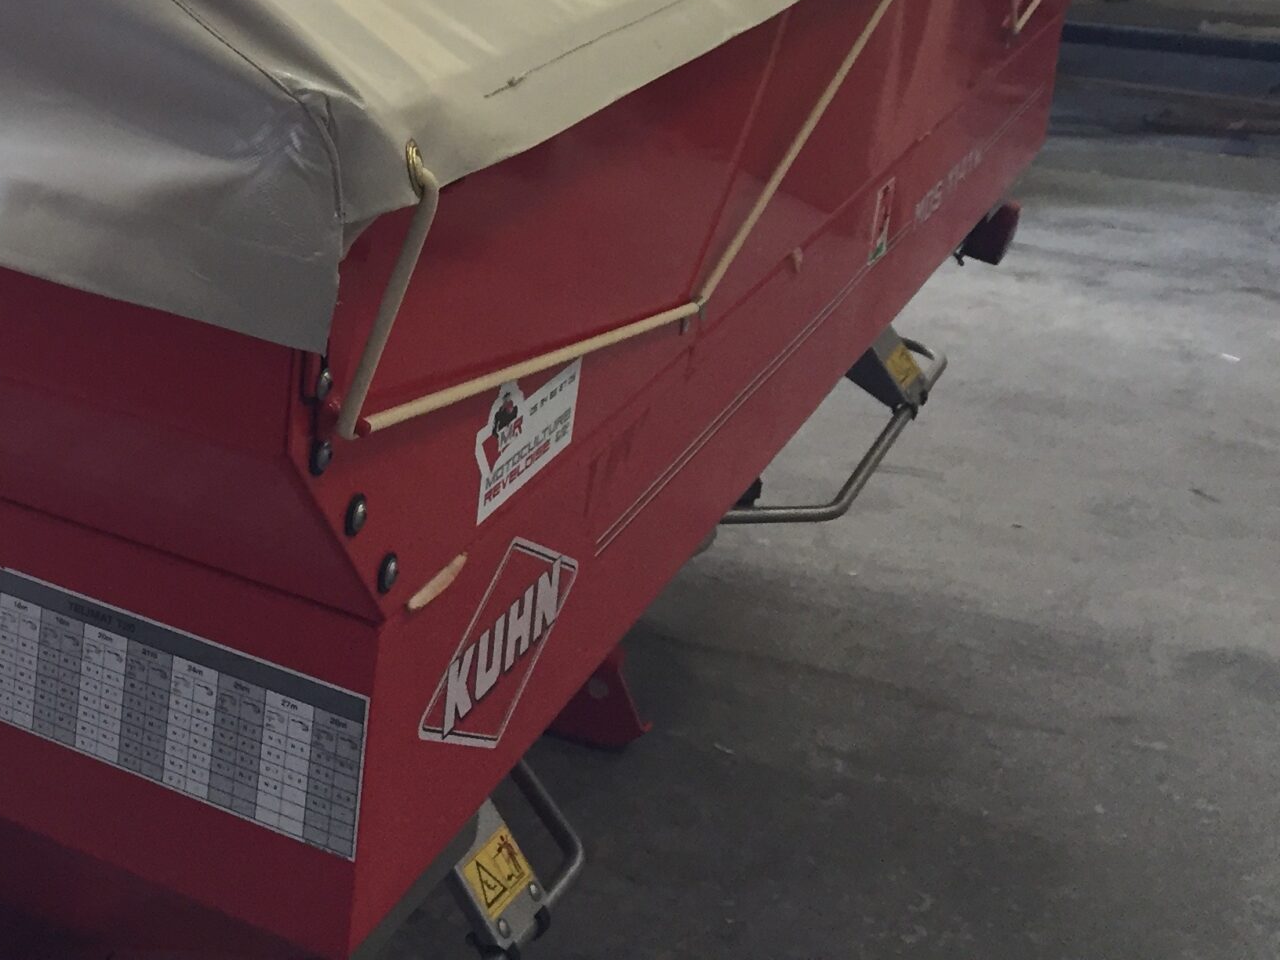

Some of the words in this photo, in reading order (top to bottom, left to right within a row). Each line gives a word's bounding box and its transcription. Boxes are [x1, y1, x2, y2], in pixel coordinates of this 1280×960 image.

[483, 439, 551, 507] REVELOISE
[484, 406, 572, 490] MOTOCULTURE
[441, 555, 563, 740] KUHN
[280, 698, 298, 711] 27m
